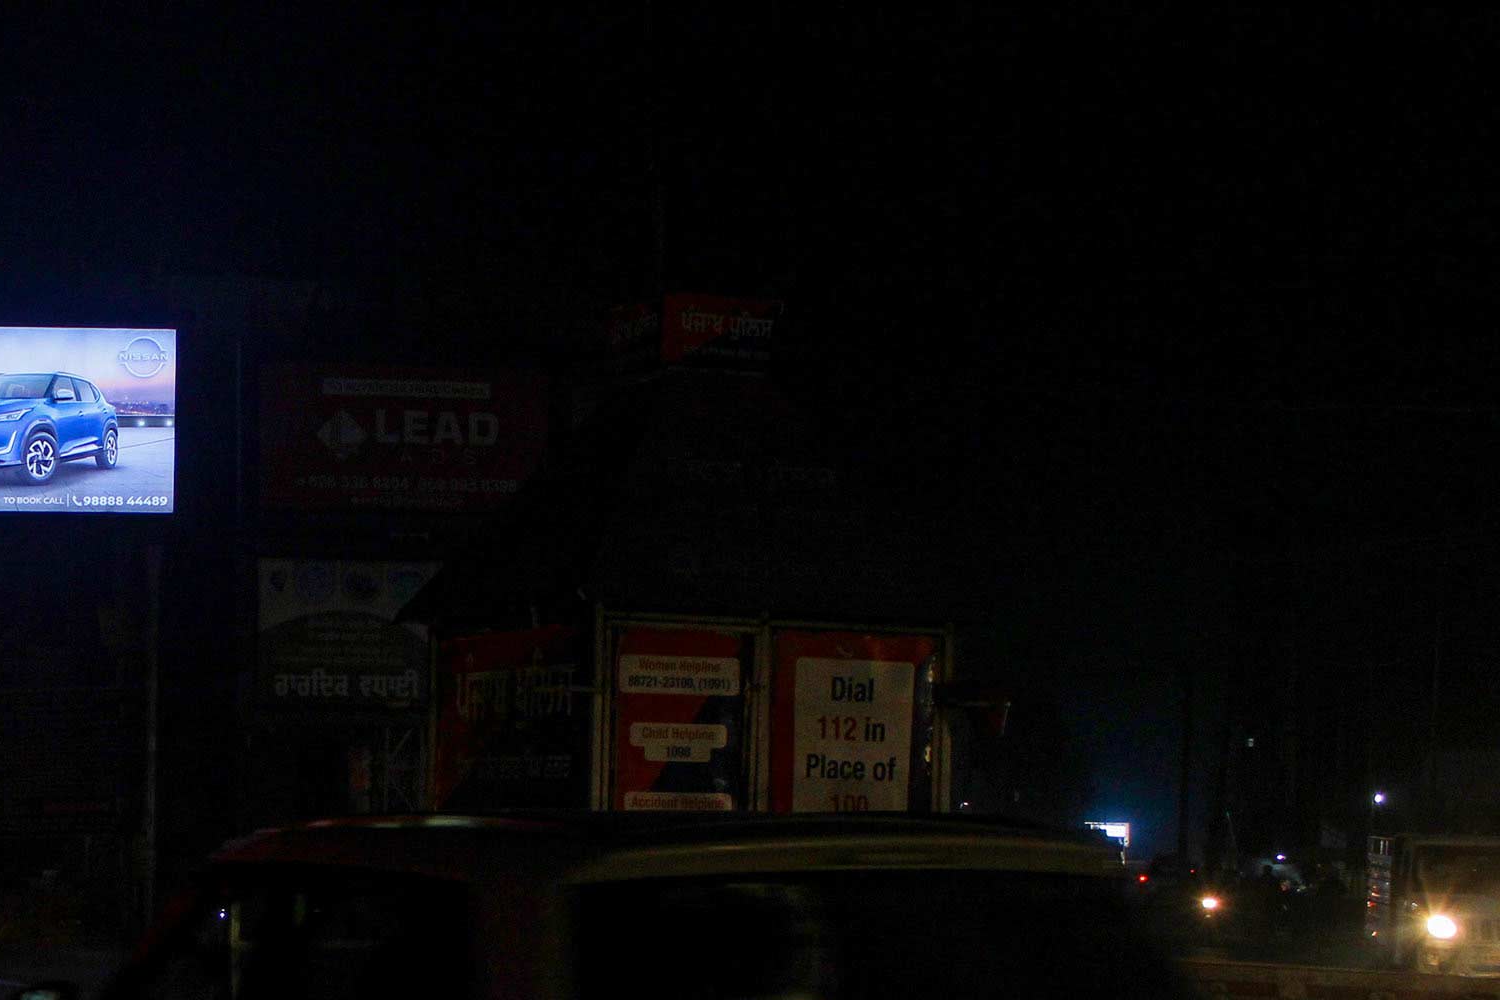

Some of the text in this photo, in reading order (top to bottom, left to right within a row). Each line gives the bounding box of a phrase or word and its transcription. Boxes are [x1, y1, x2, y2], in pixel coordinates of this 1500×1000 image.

[374, 408, 499, 446] LEAD
[3, 496, 65, 505] TO BOOK CALL
[83, 496, 168, 506] 98888 44489
[831, 677, 874, 702] Dial
[818, 716, 885, 742] 112 in
[806, 754, 896, 781] Place of
